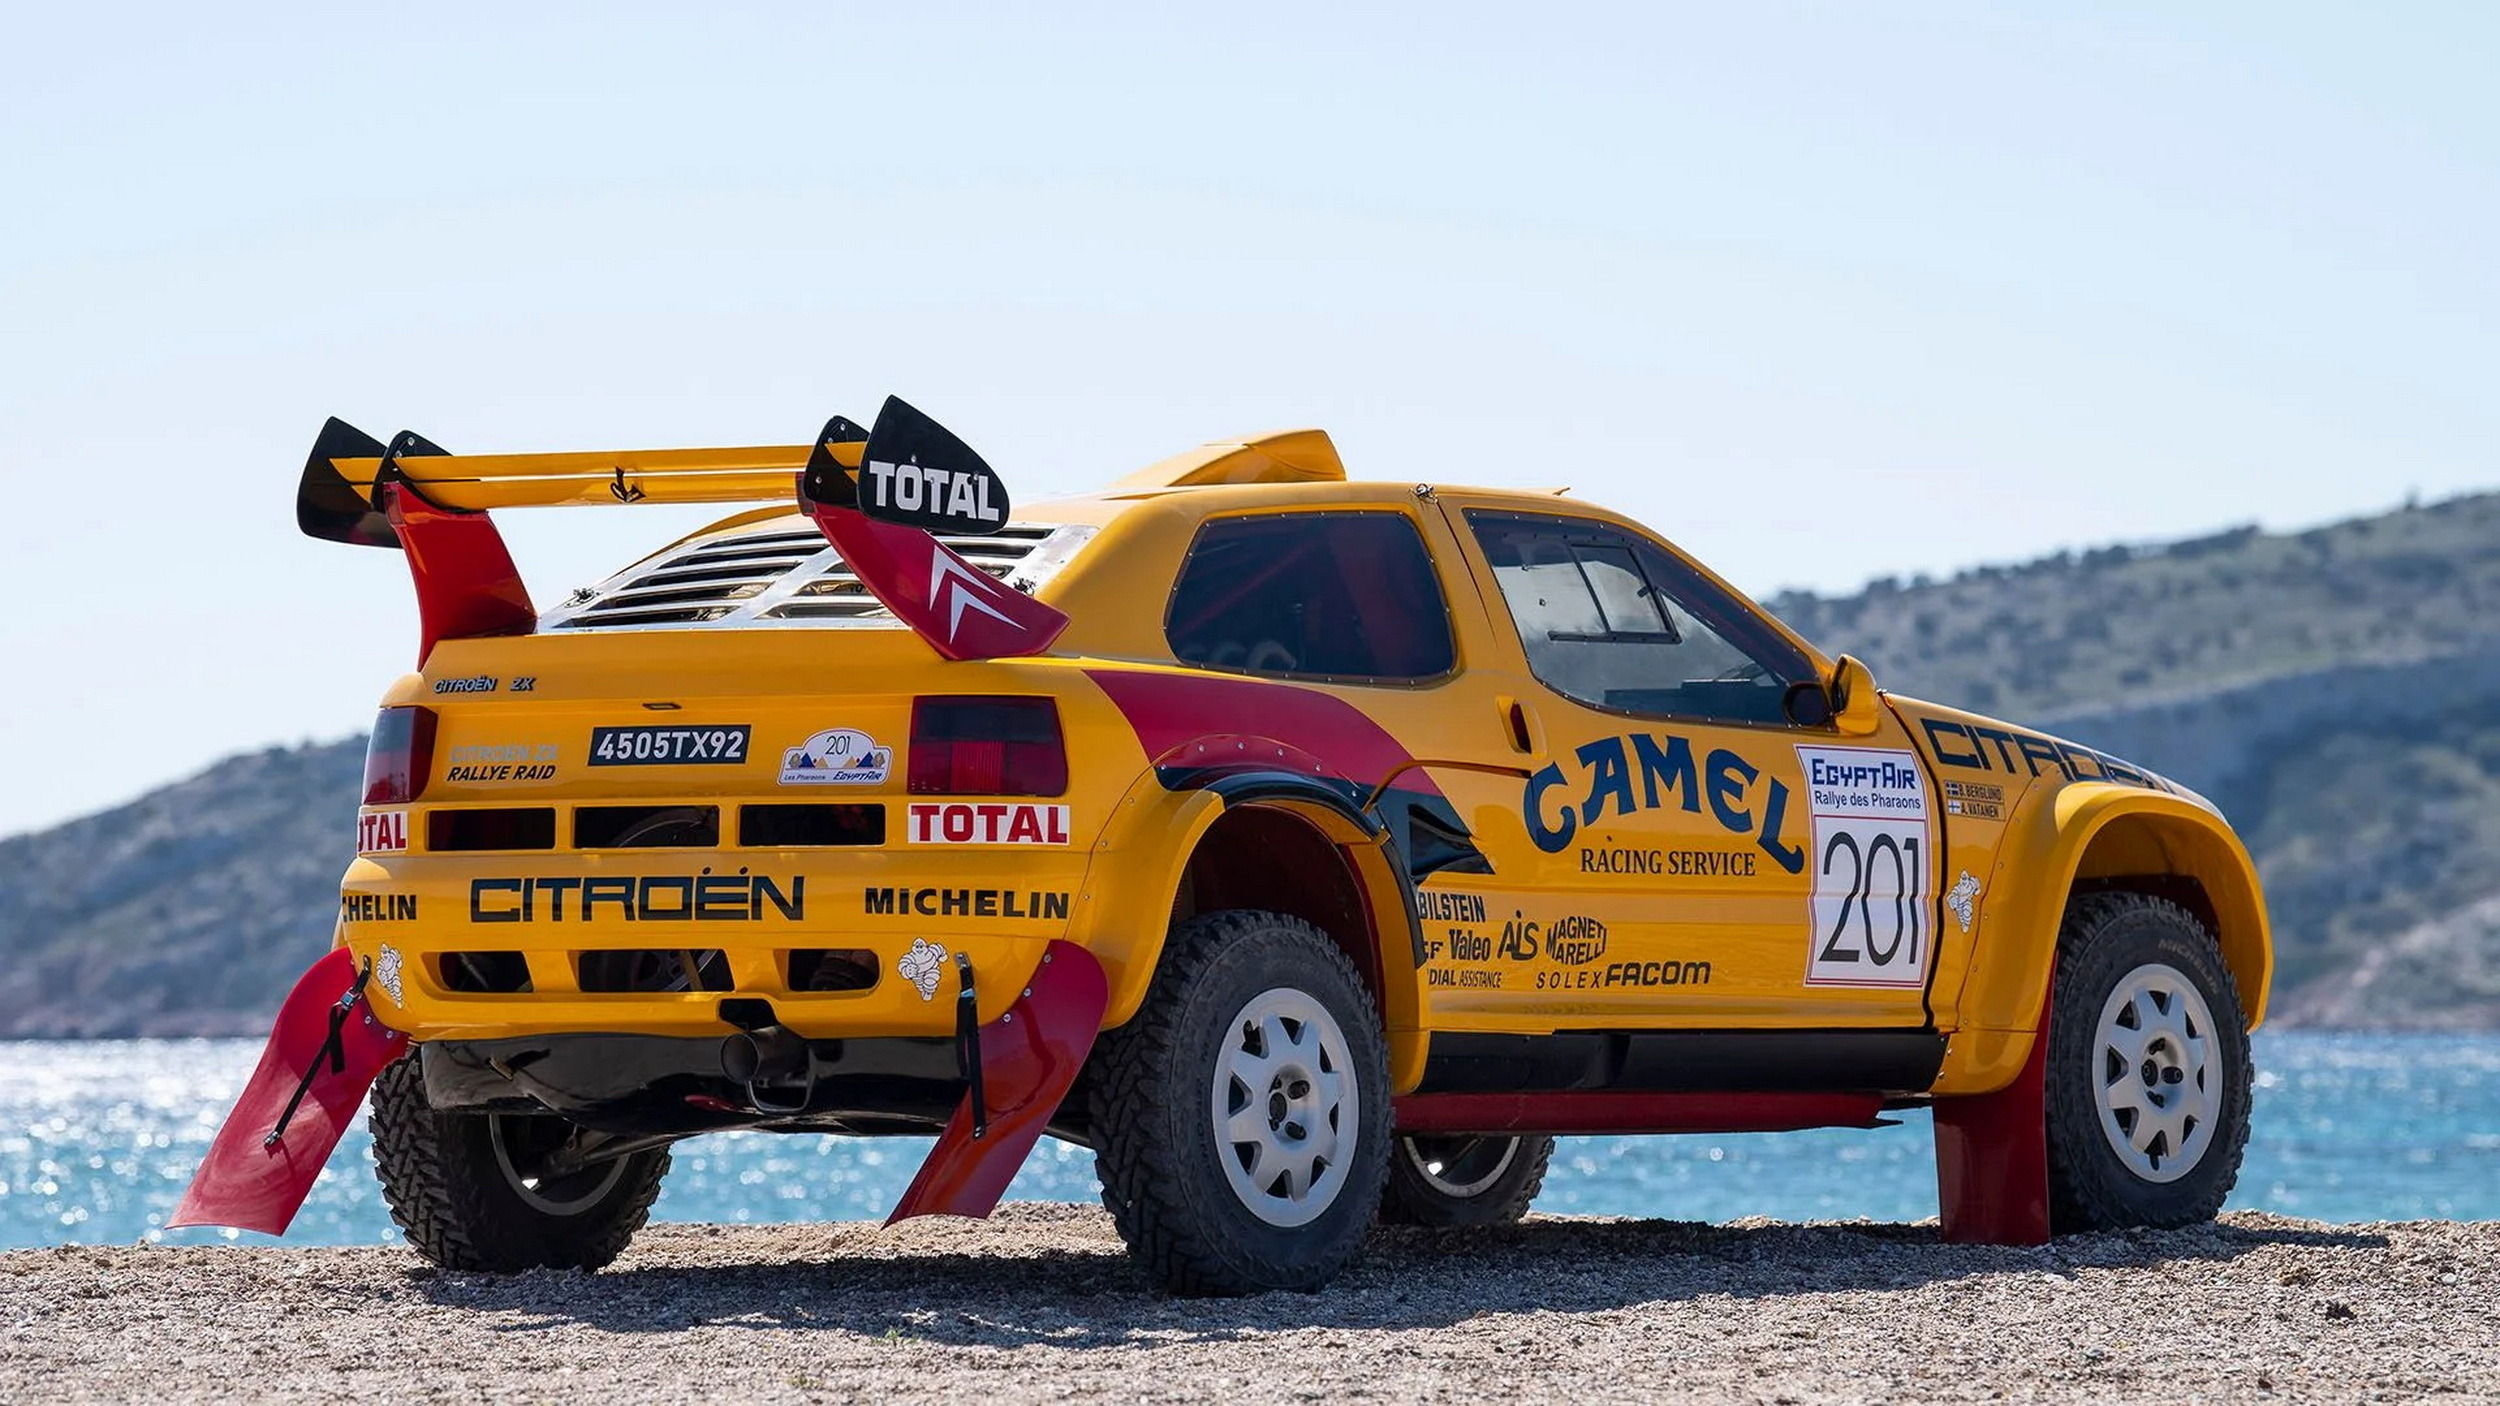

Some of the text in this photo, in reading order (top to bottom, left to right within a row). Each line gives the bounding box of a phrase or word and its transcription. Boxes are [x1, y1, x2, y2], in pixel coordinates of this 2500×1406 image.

[869, 460, 1000, 522] TOTAL
[510, 677, 537, 692] ZX
[596, 729, 745, 761] 4505TX92
[825, 735, 851, 755] 201
[446, 765, 557, 782] RALLYE RAID
[1522, 733, 1805, 875] CAMEL
[1814, 790, 1921, 809] Rallye des Pharaons
[910, 804, 1068, 844] TOTAL
[1581, 848, 1756, 876] RACING SERVICE
[864, 887, 1070, 919] MICHELIN
[1418, 892, 1486, 923] BILSTEIN
[1818, 831, 1919, 967] 201
[1448, 929, 1491, 962] Valeo
[1459, 970, 1502, 988] ASSISTANCE
[1536, 971, 1602, 989] SOLEX
[1603, 960, 1712, 987] FACOM
